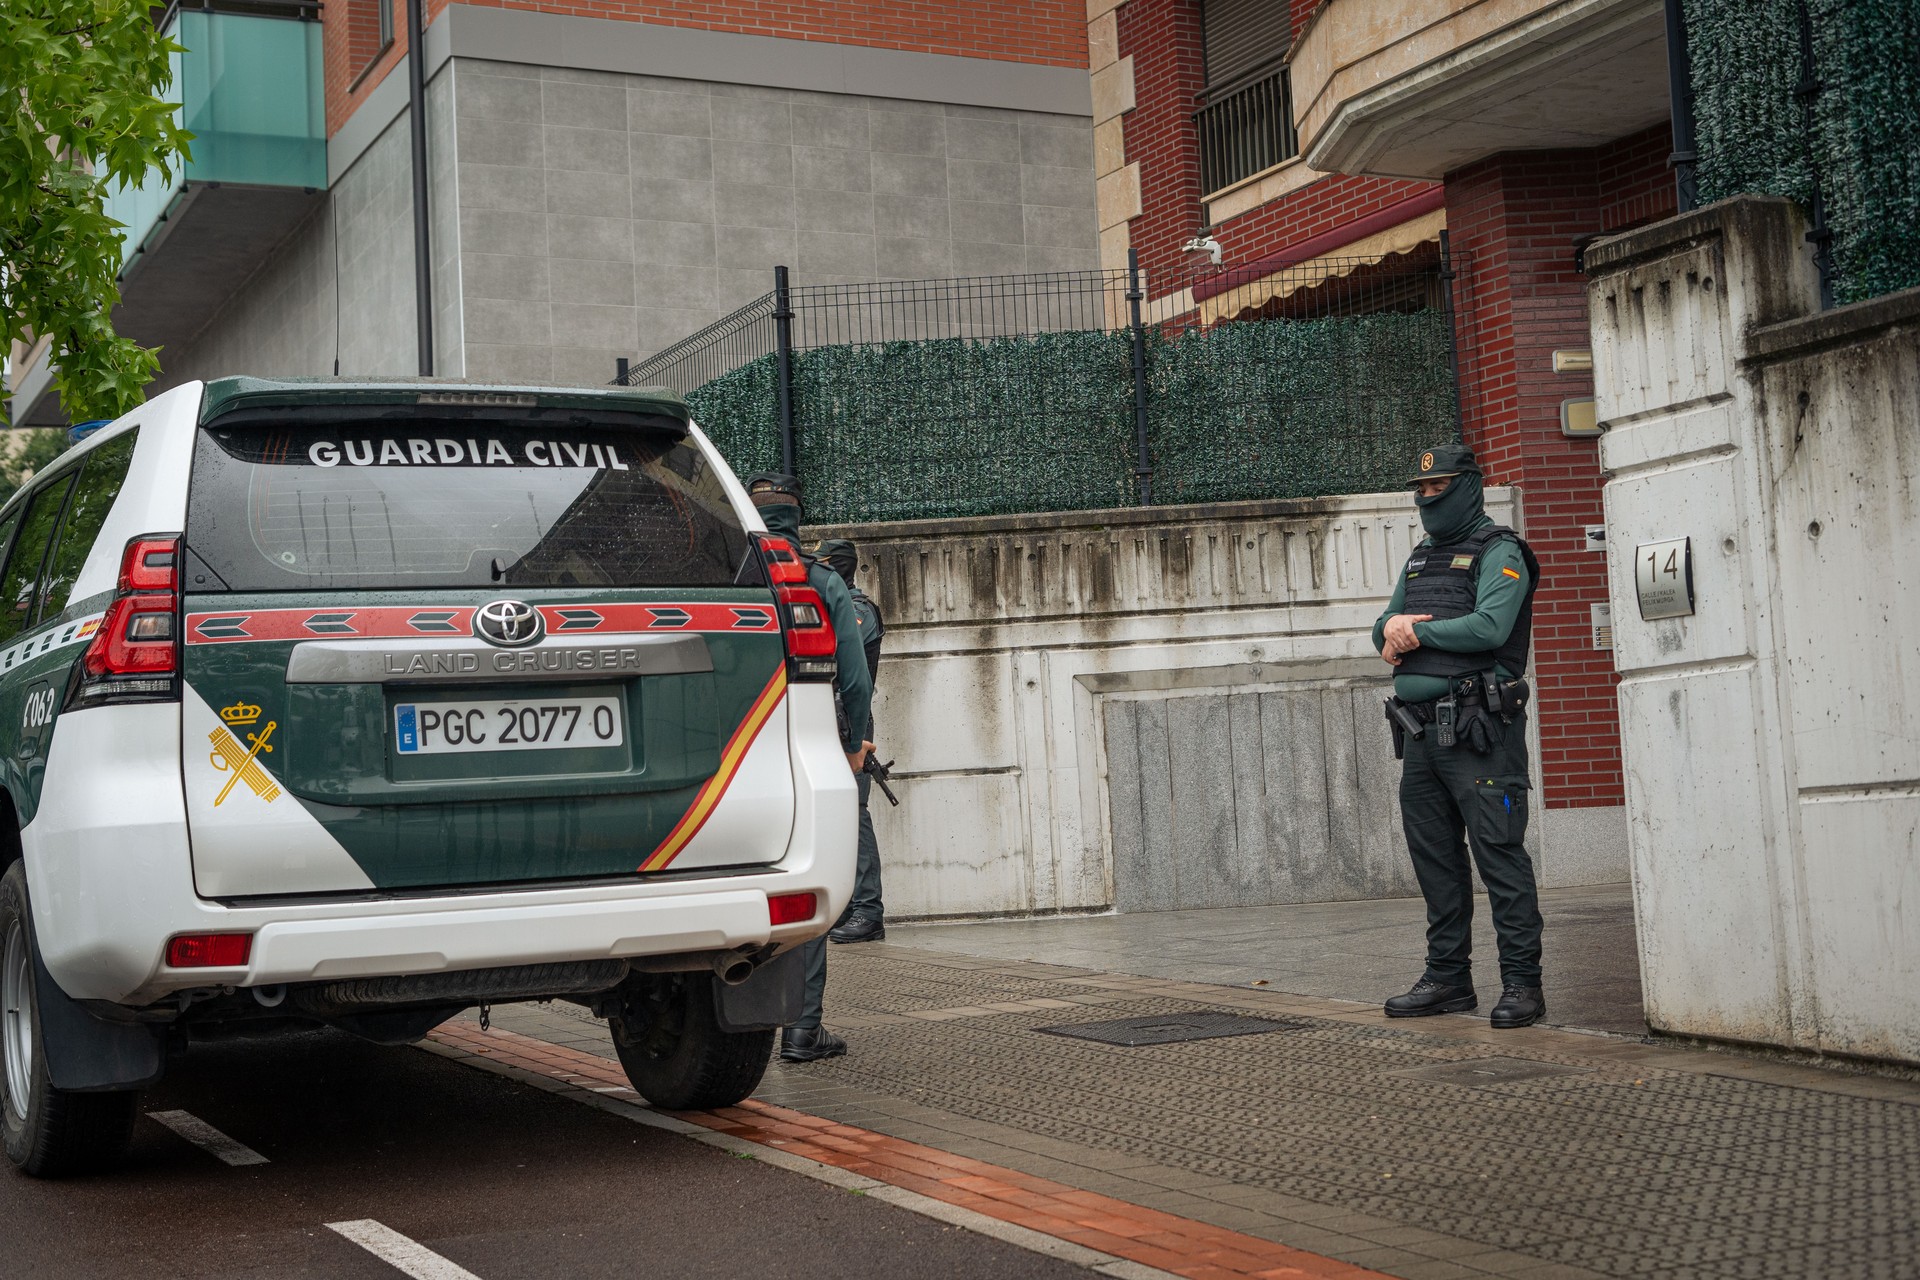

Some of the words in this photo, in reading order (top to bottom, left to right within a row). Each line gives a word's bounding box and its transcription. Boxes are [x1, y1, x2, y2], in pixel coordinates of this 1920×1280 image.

[308, 439, 515, 468] GUARDIA
[524, 440, 629, 471] CIVIL
[1647, 548, 1678, 583] 14
[384, 653, 480, 674] LAND
[492, 649, 641, 672] CRUISER
[31, 687, 55, 727] 062
[404, 733, 413, 744] E
[420, 709, 486, 746] PGC
[497, 705, 582, 744] 2077
